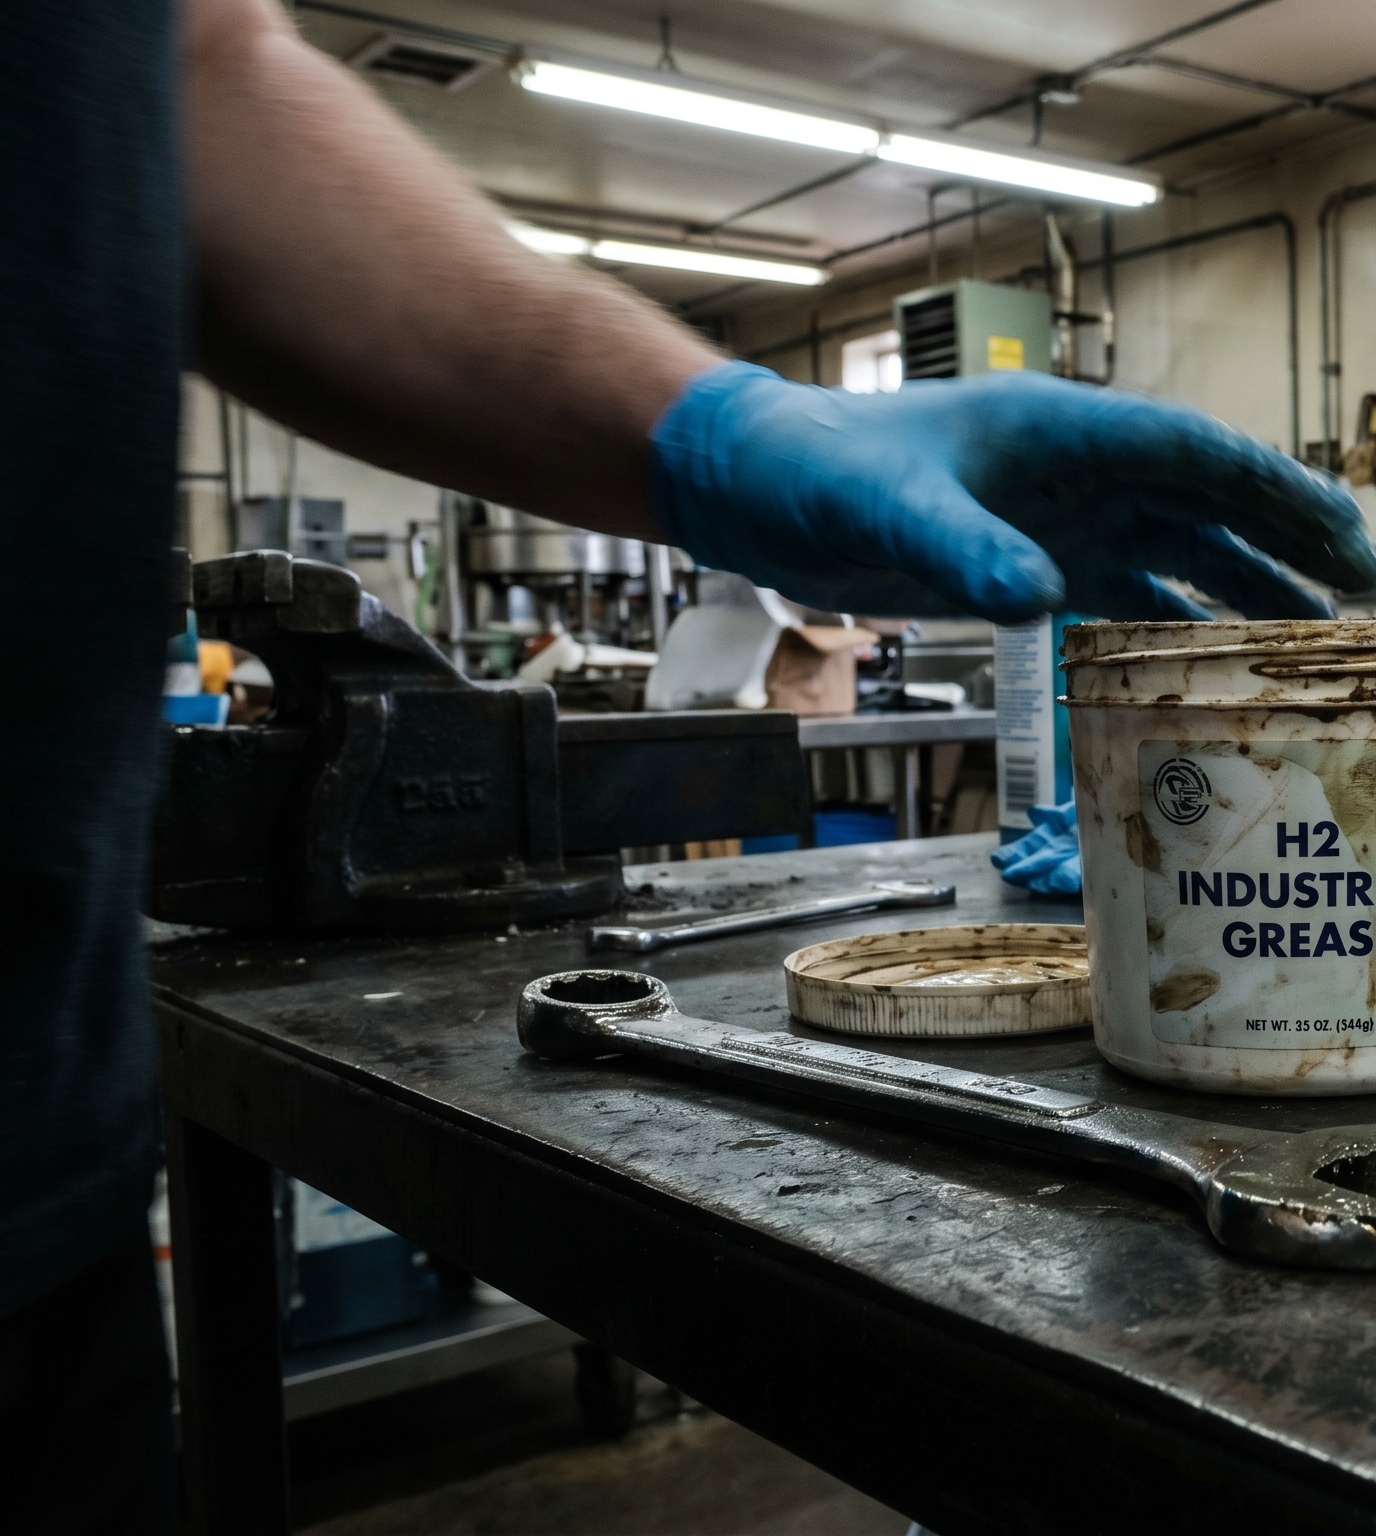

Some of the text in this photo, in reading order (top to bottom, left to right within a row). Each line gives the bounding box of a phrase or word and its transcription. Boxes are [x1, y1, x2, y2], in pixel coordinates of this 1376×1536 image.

[1276, 820, 1340, 858] H2
[1246, 1019, 1267, 1031] NET
[1271, 1019, 1291, 1031] WT.
[1295, 1020, 1310, 1032] 35
[1313, 1020, 1333, 1032] OZ.
